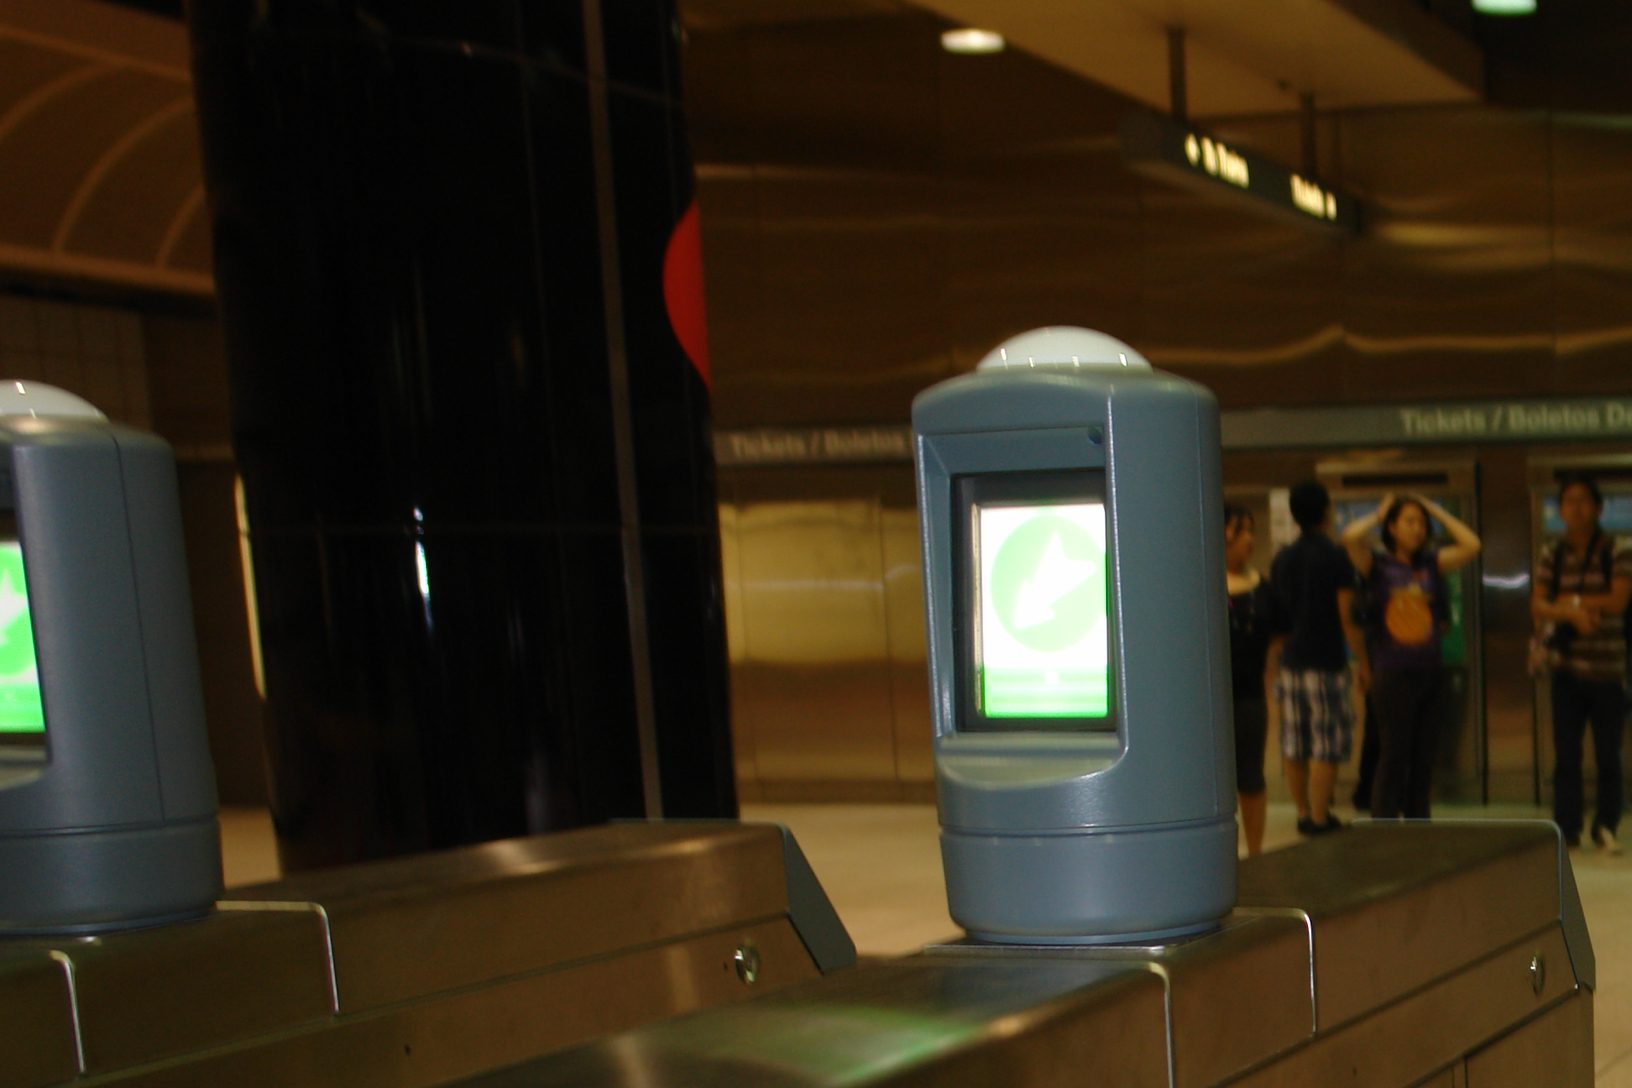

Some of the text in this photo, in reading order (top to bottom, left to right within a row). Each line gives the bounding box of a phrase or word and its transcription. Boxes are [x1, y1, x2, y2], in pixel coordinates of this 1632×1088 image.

[1400, 407, 1486, 434] Tickets
[1491, 406, 1502, 432] /
[1508, 404, 1600, 431] Boletos
